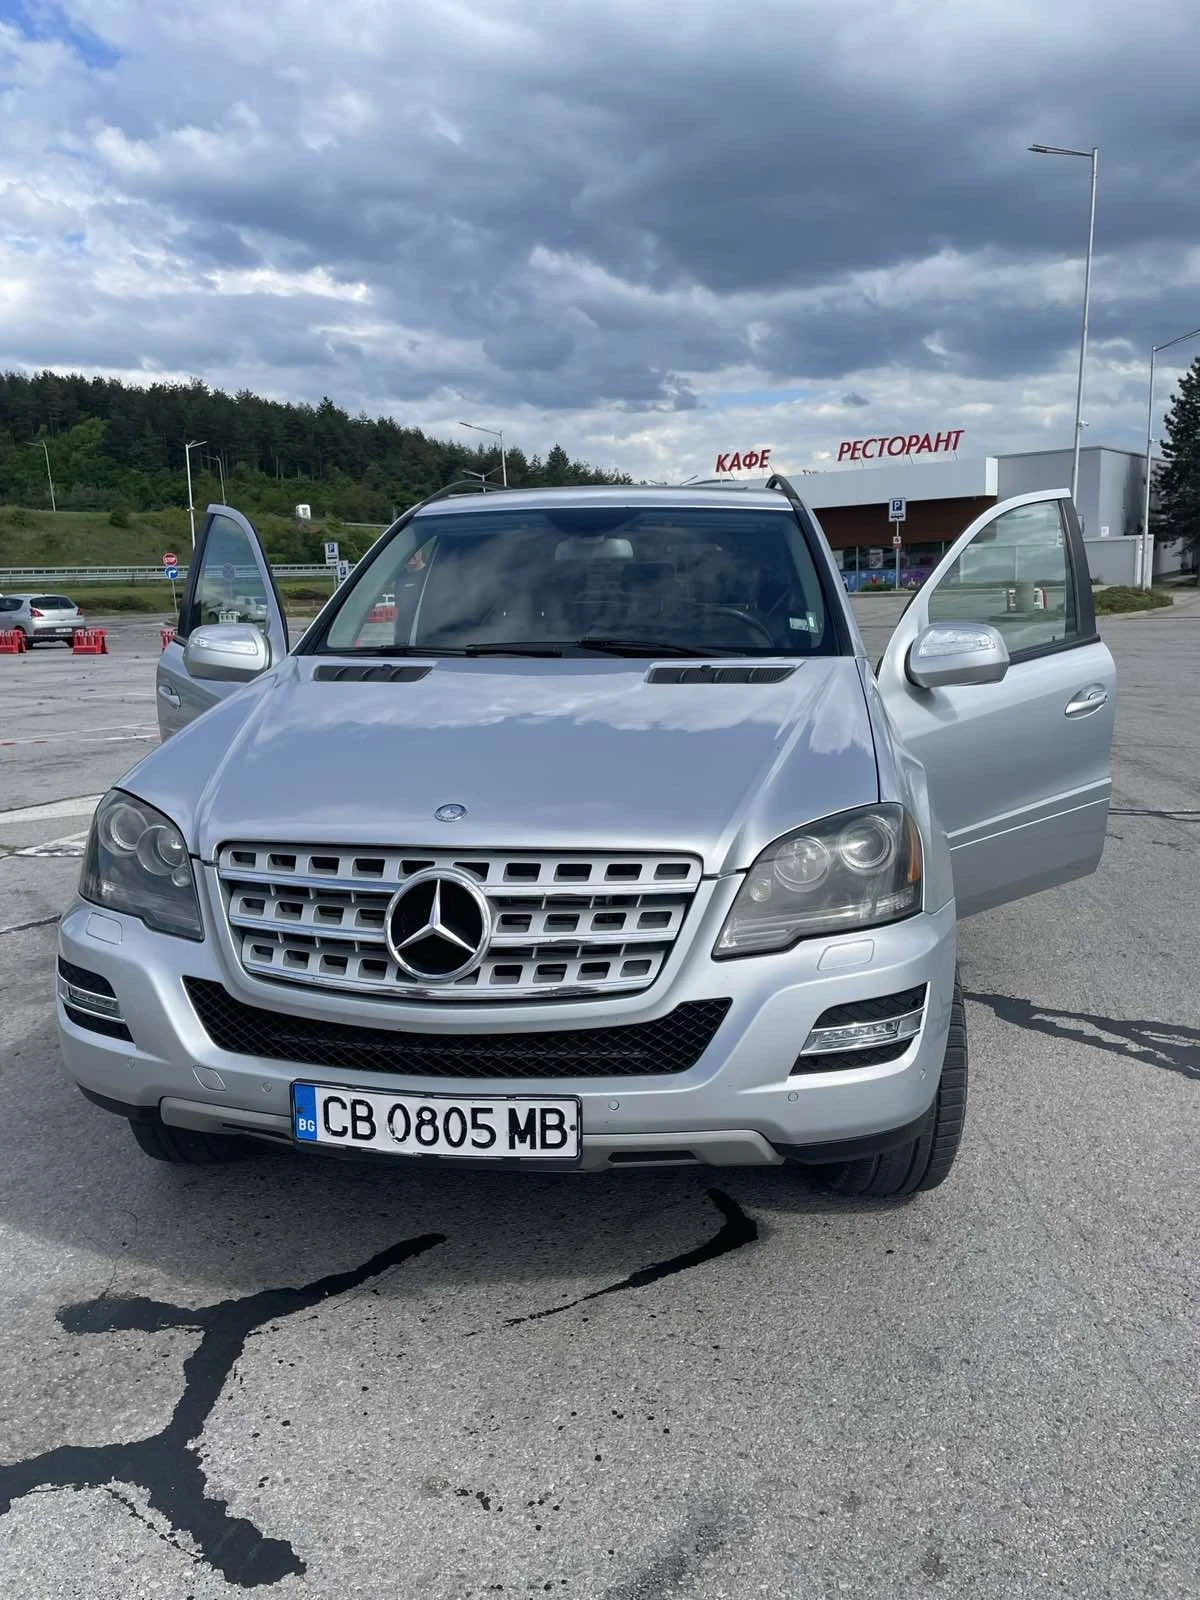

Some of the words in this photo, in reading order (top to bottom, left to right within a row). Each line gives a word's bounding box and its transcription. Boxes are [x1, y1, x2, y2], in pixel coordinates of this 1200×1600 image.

[837, 430, 965, 462] РЕСТОРАНТ
[715, 448, 772, 473] КАФЕ
[298, 1117, 316, 1132] BG
[322, 1095, 377, 1141] CB
[387, 1103, 497, 1149] 0805
[508, 1106, 569, 1150] MB
